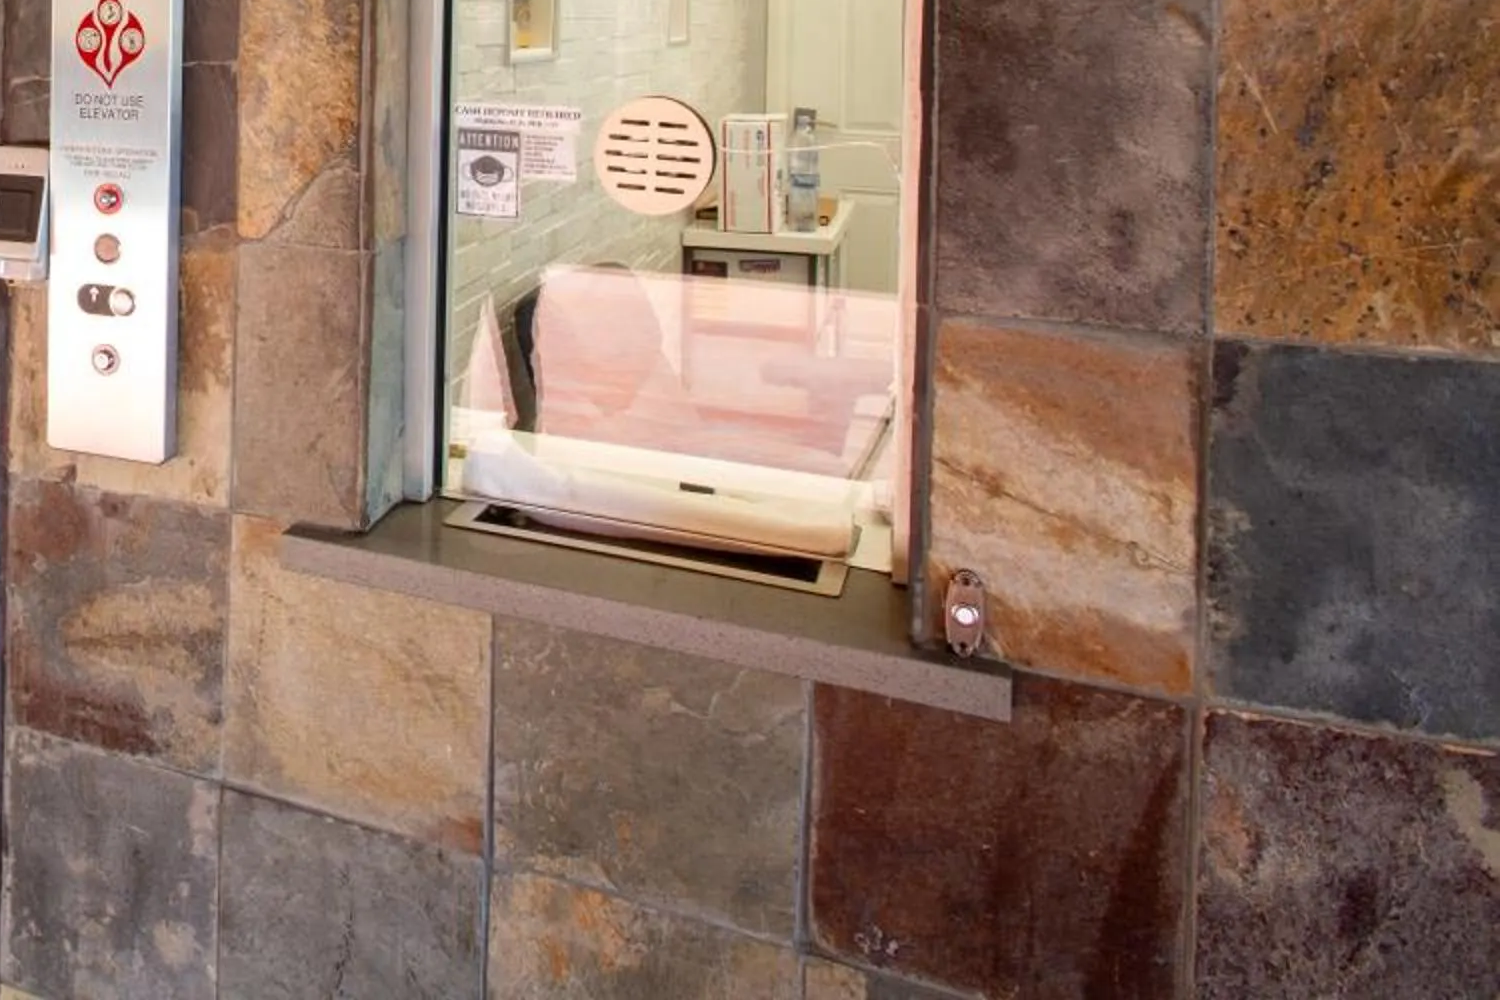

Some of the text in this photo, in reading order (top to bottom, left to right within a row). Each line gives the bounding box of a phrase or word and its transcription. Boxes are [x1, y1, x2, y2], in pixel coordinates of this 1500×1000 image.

[75, 93, 143, 107] DO NOT USE
[79, 107, 138, 120] ELEVATOR
[459, 132, 519, 150] ATTENTION
